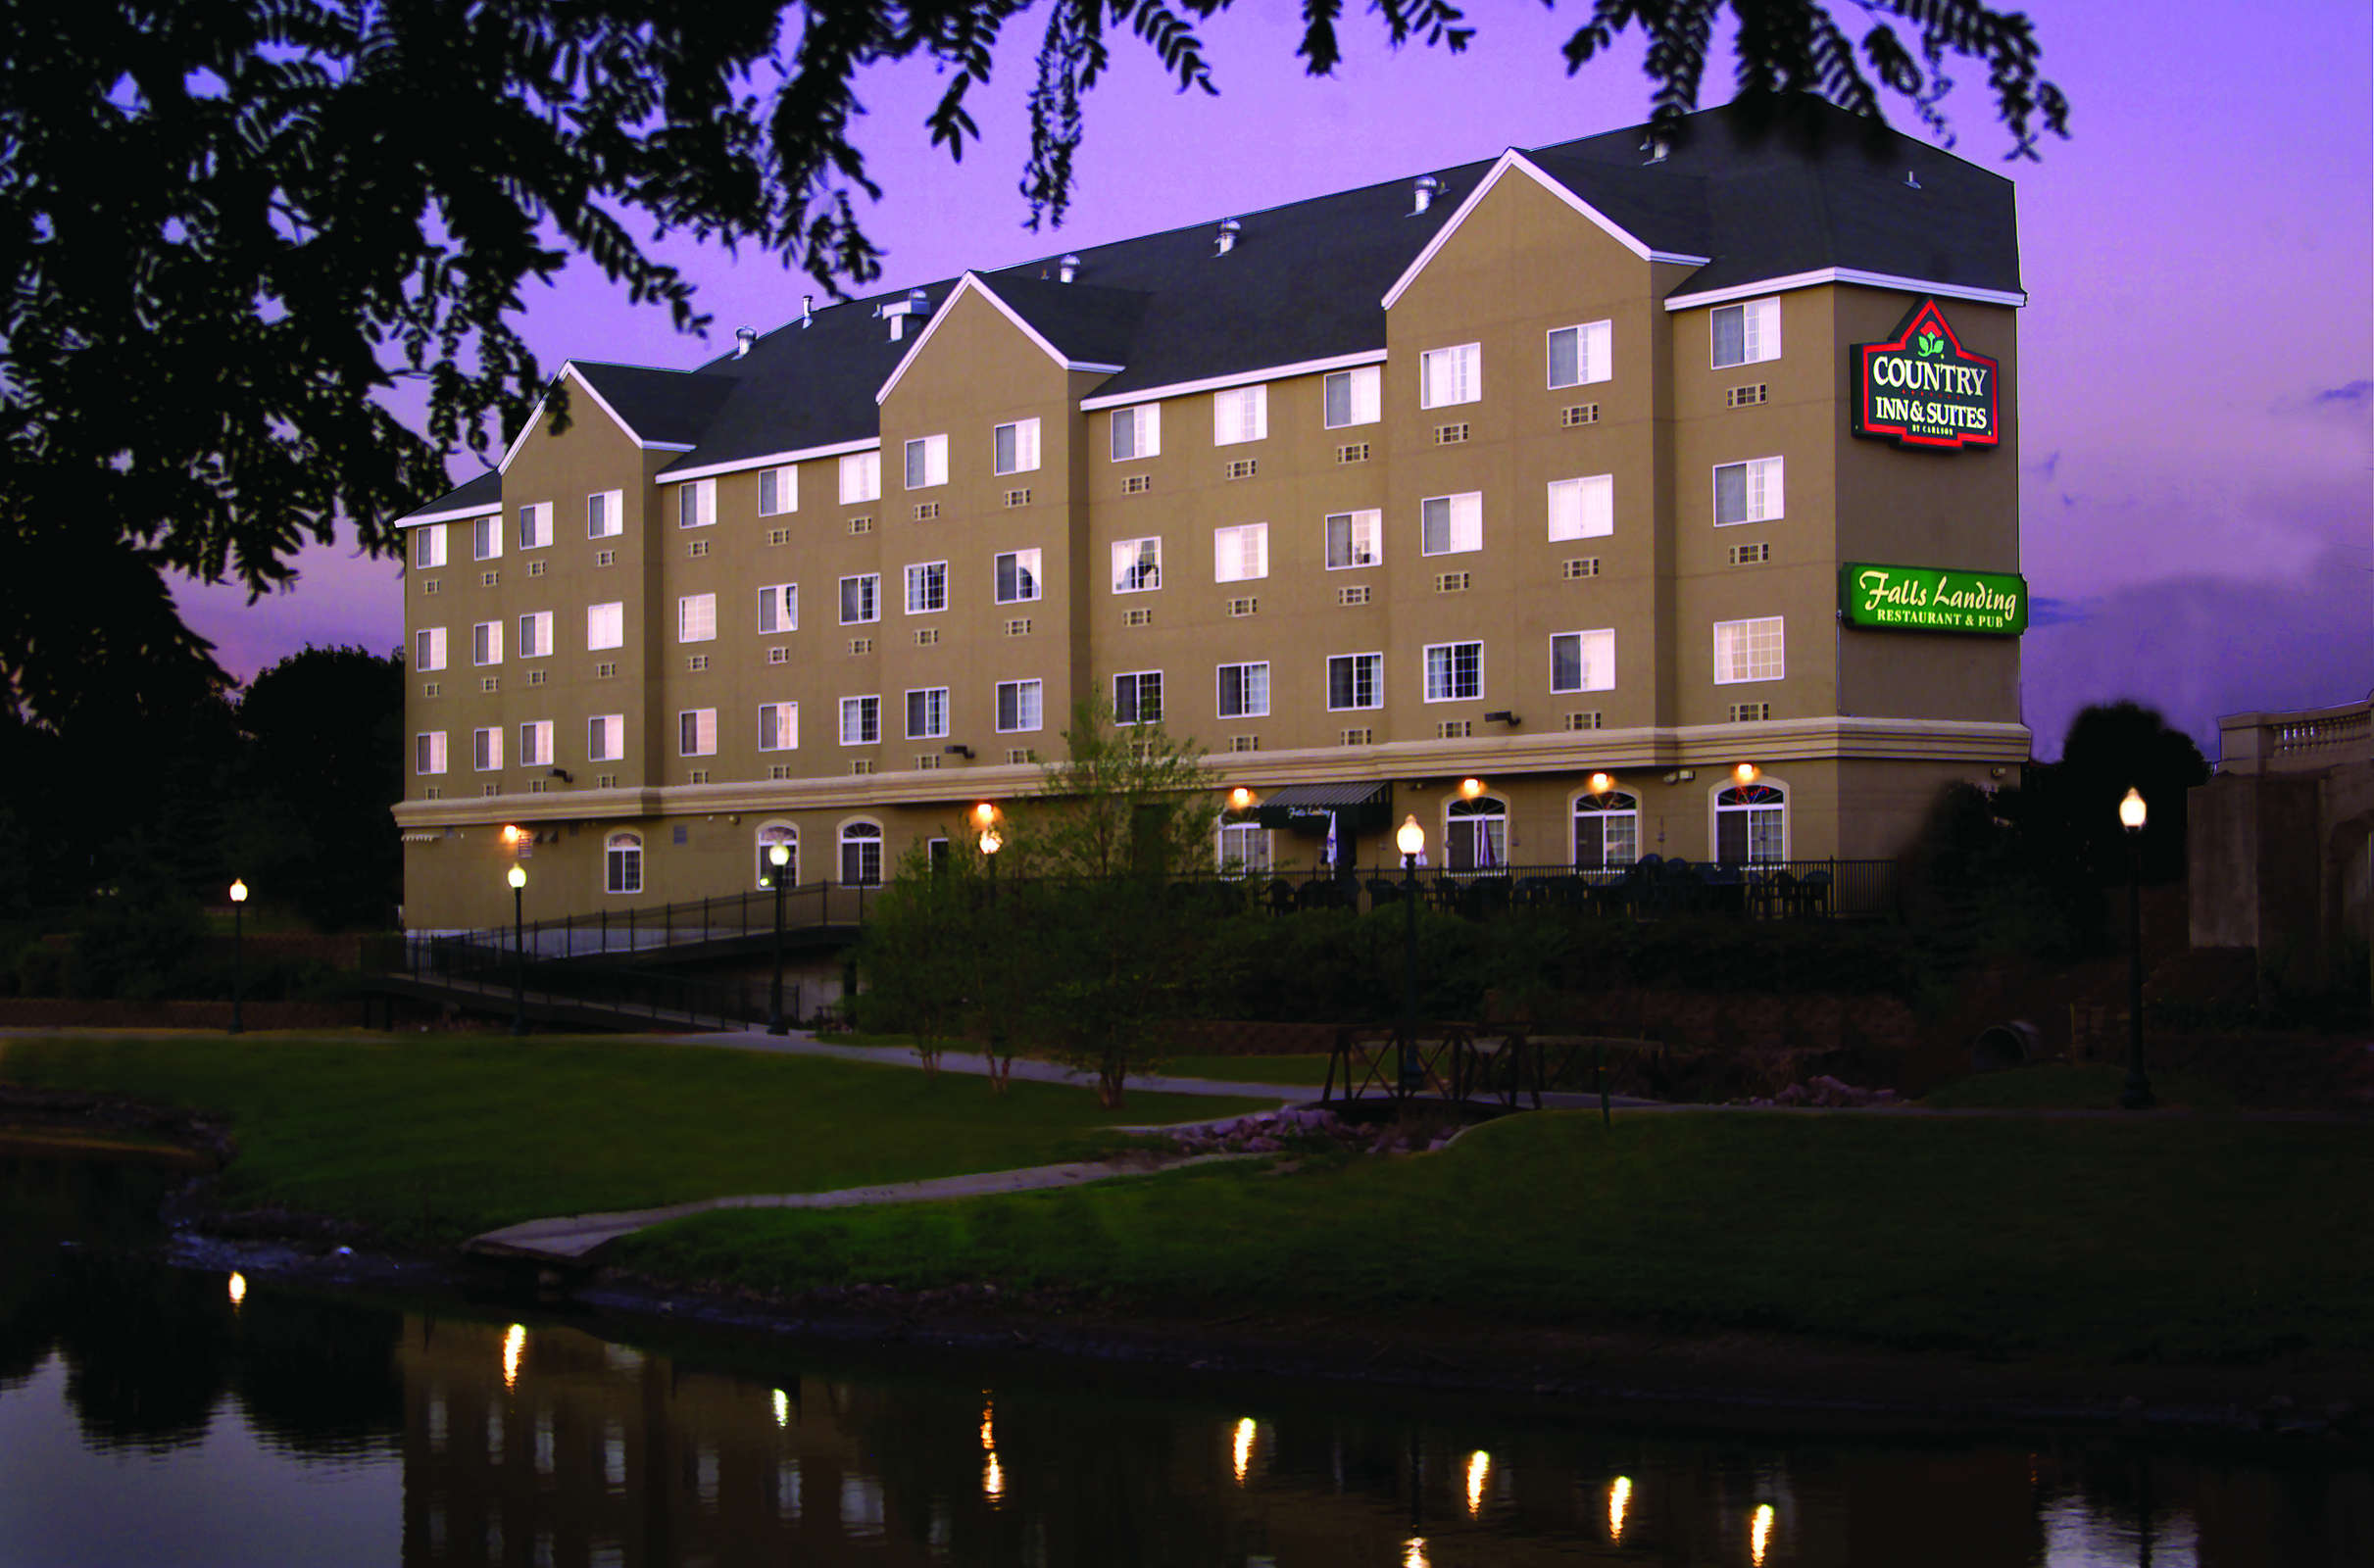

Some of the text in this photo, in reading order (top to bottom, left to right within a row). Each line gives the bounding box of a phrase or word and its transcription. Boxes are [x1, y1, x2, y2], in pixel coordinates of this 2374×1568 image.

[1873, 356, 1987, 396] COUNTRY
[1875, 396, 1987, 429] INN & SUITES
[1859, 570, 2016, 620] Falls Landing
[1877, 609, 2003, 628] RESTAURANT & PUB
